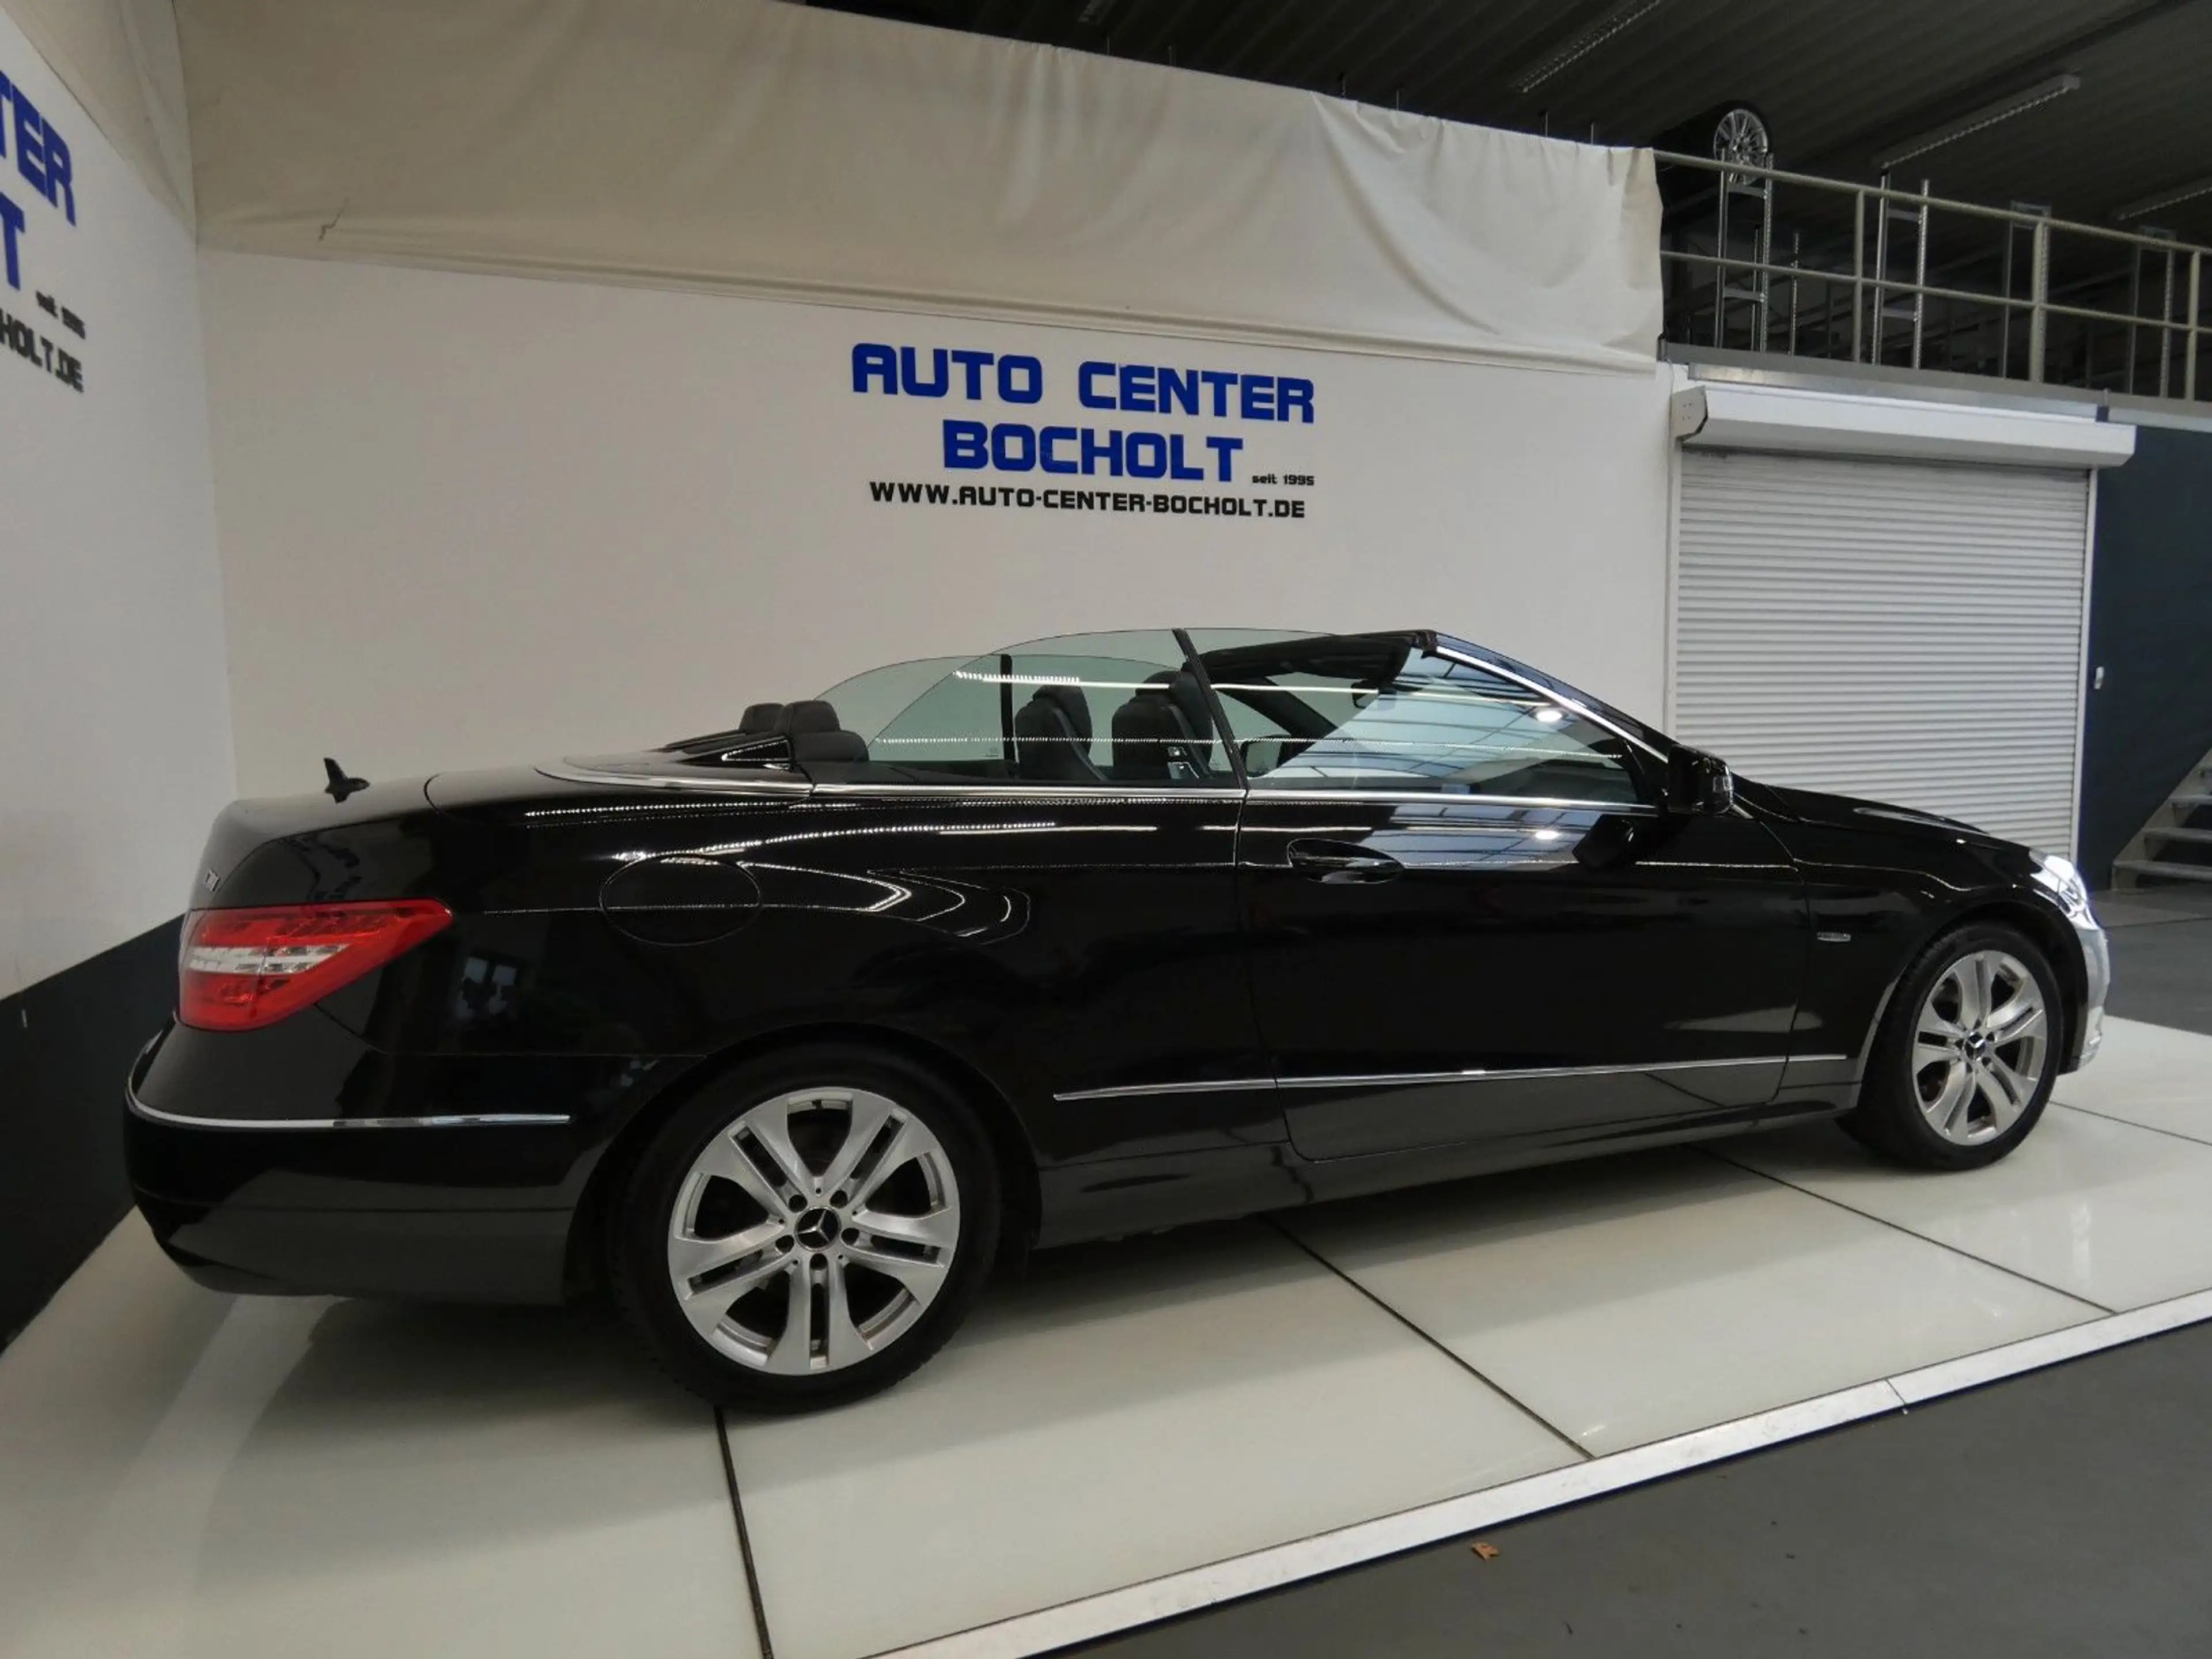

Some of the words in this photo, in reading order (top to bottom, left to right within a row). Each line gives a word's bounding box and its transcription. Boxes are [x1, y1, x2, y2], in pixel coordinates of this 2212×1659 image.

[851, 343, 1044, 405] AUTO
[1078, 361, 1315, 425] CENTER
[942, 419, 1244, 483] BOCHOLT
[869, 481, 1305, 518] WWW.AUTO-CENTER-BOCHOLT.DE
[1252, 474, 1277, 484] seit
[1283, 474, 1315, 486] 1995
